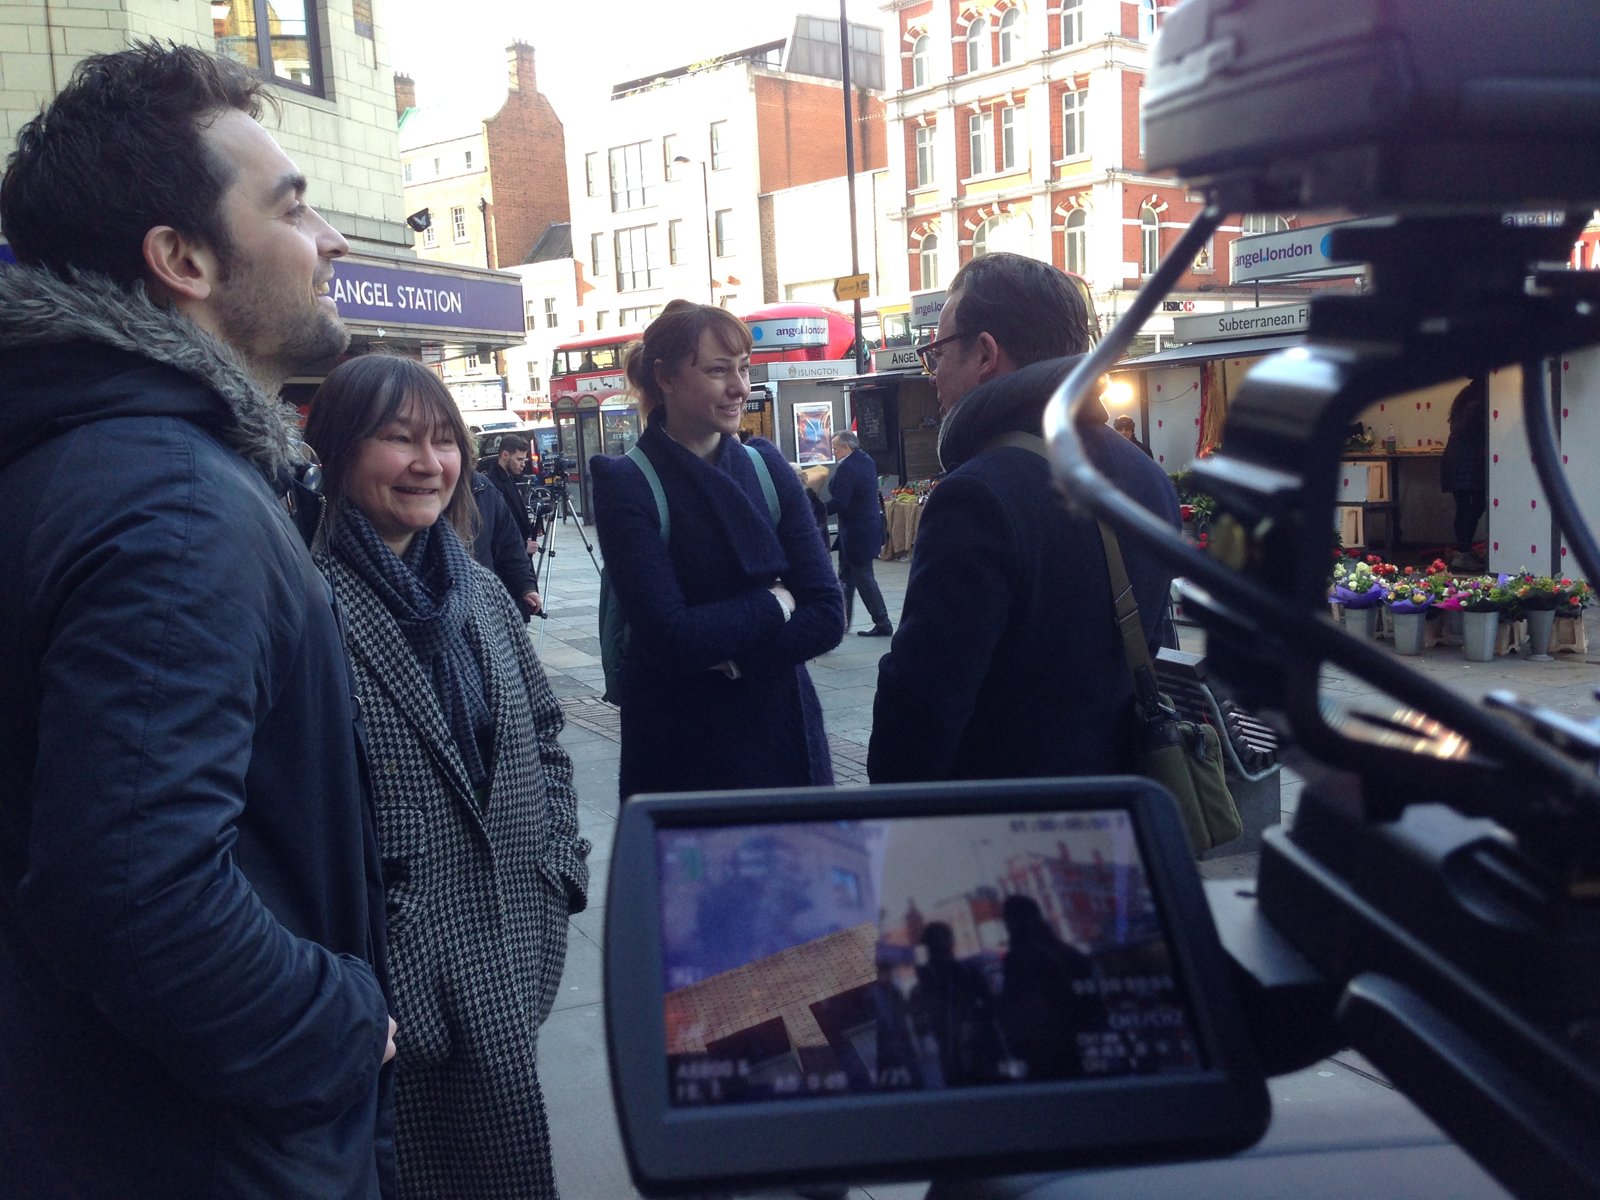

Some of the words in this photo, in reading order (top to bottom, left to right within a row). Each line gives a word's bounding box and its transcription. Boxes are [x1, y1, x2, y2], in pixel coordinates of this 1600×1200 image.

[1234, 243, 1312, 268] angel.london
[333, 278, 393, 307] ANGEL
[397, 285, 462, 313] STATION
[1218, 314, 1295, 332] Subterranean
[1298, 308, 1309, 323] Fl
[891, 352, 918, 365] ANGEL
[798, 367, 839, 377] ISLINGTON
[743, 402, 760, 410] FFEE
